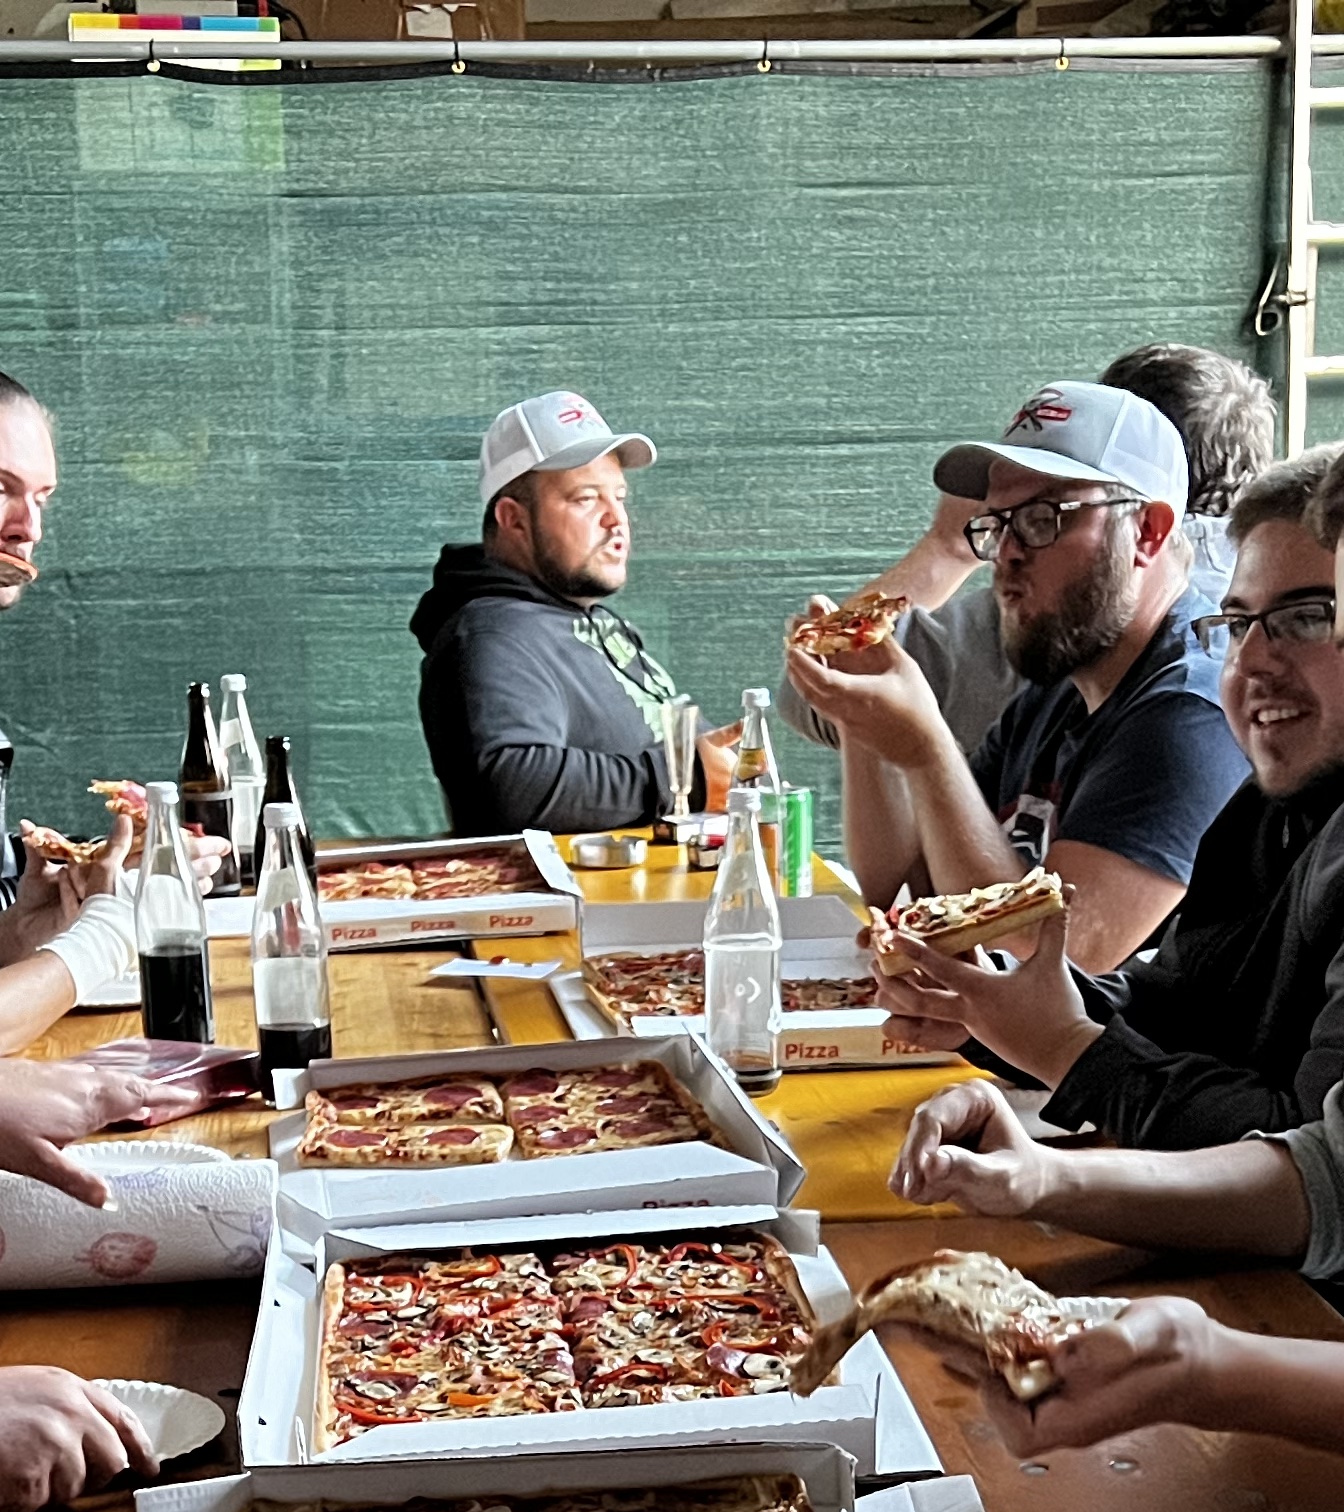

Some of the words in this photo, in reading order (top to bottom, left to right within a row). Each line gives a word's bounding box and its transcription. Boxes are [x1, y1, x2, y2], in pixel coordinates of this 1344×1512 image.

[331, 926, 377, 941] Pizza
[410, 919, 455, 932] Pizza
[489, 913, 534, 928] Pizza
[784, 1042, 840, 1060] Pizza
[882, 1039, 932, 1055] Pizz
